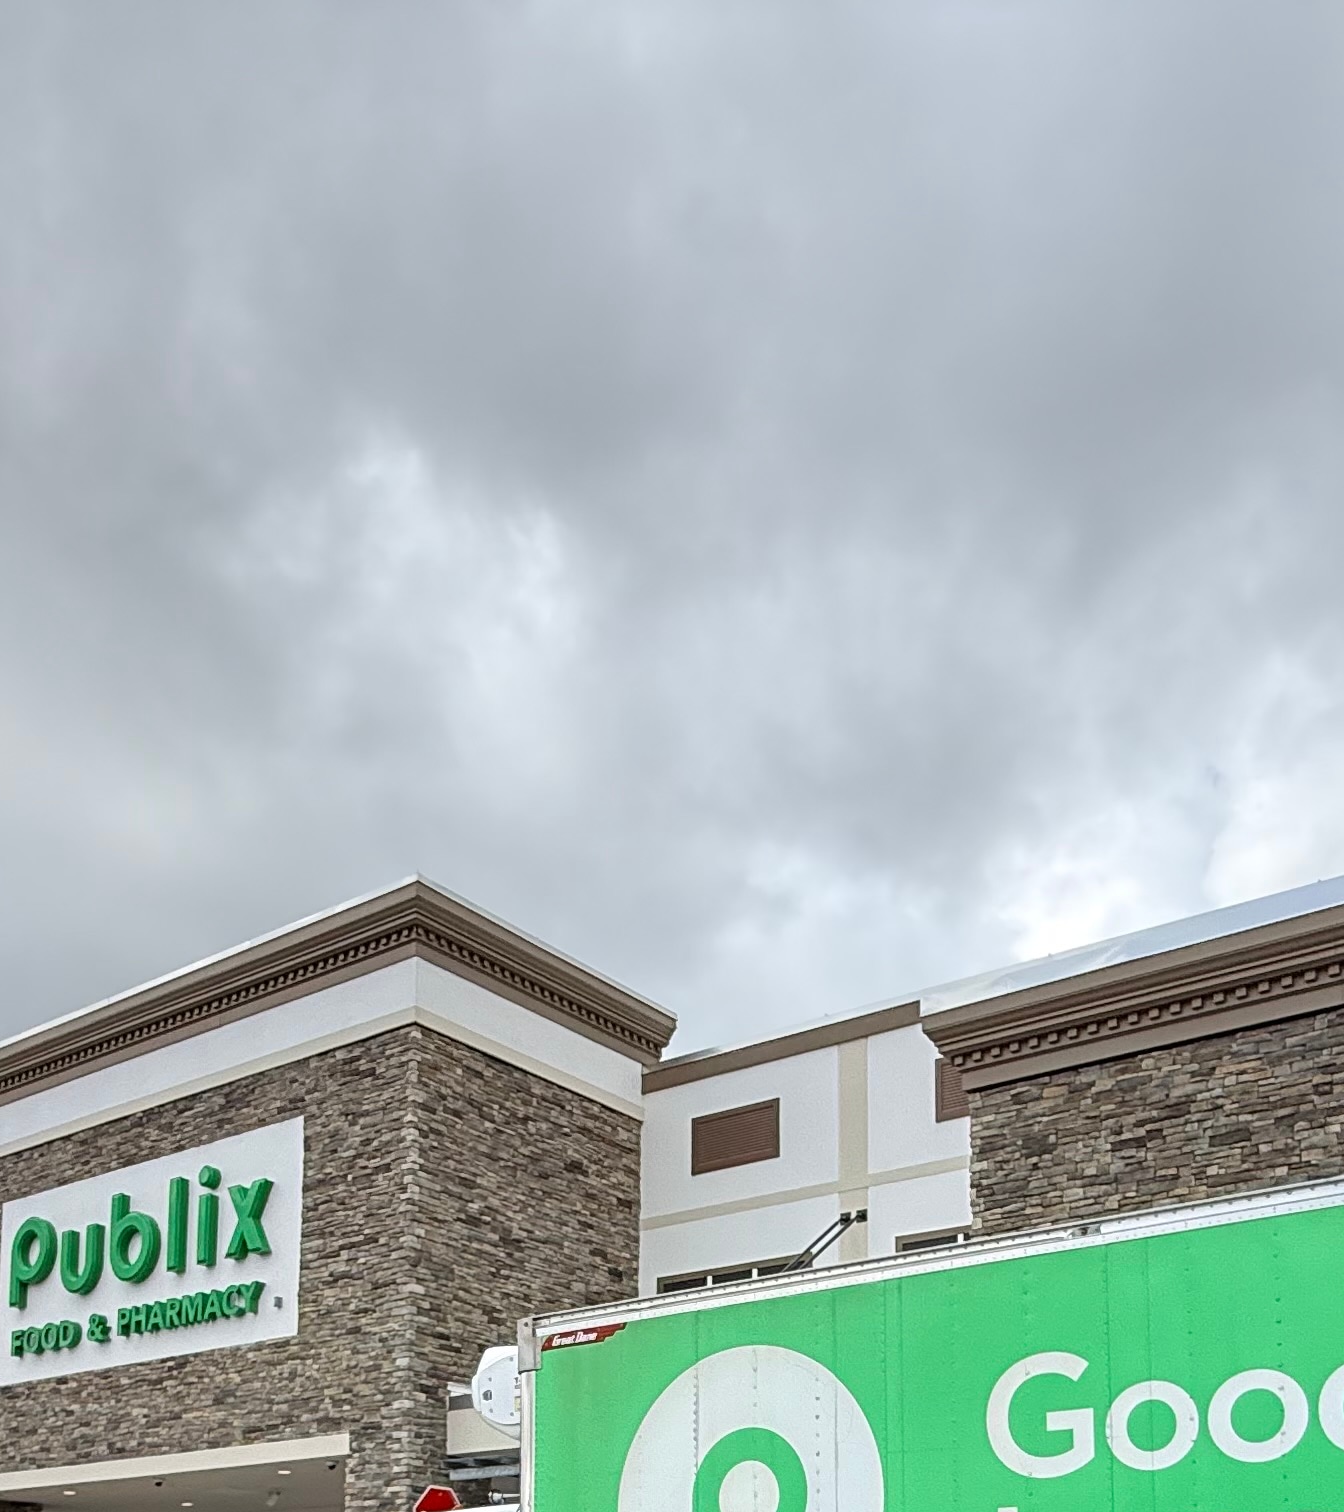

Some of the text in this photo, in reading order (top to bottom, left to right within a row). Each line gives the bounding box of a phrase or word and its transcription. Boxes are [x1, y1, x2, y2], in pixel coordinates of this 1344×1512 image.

[9, 1165, 274, 1310] Publix
[11, 1280, 267, 1357] FOOD & PHARMACY
